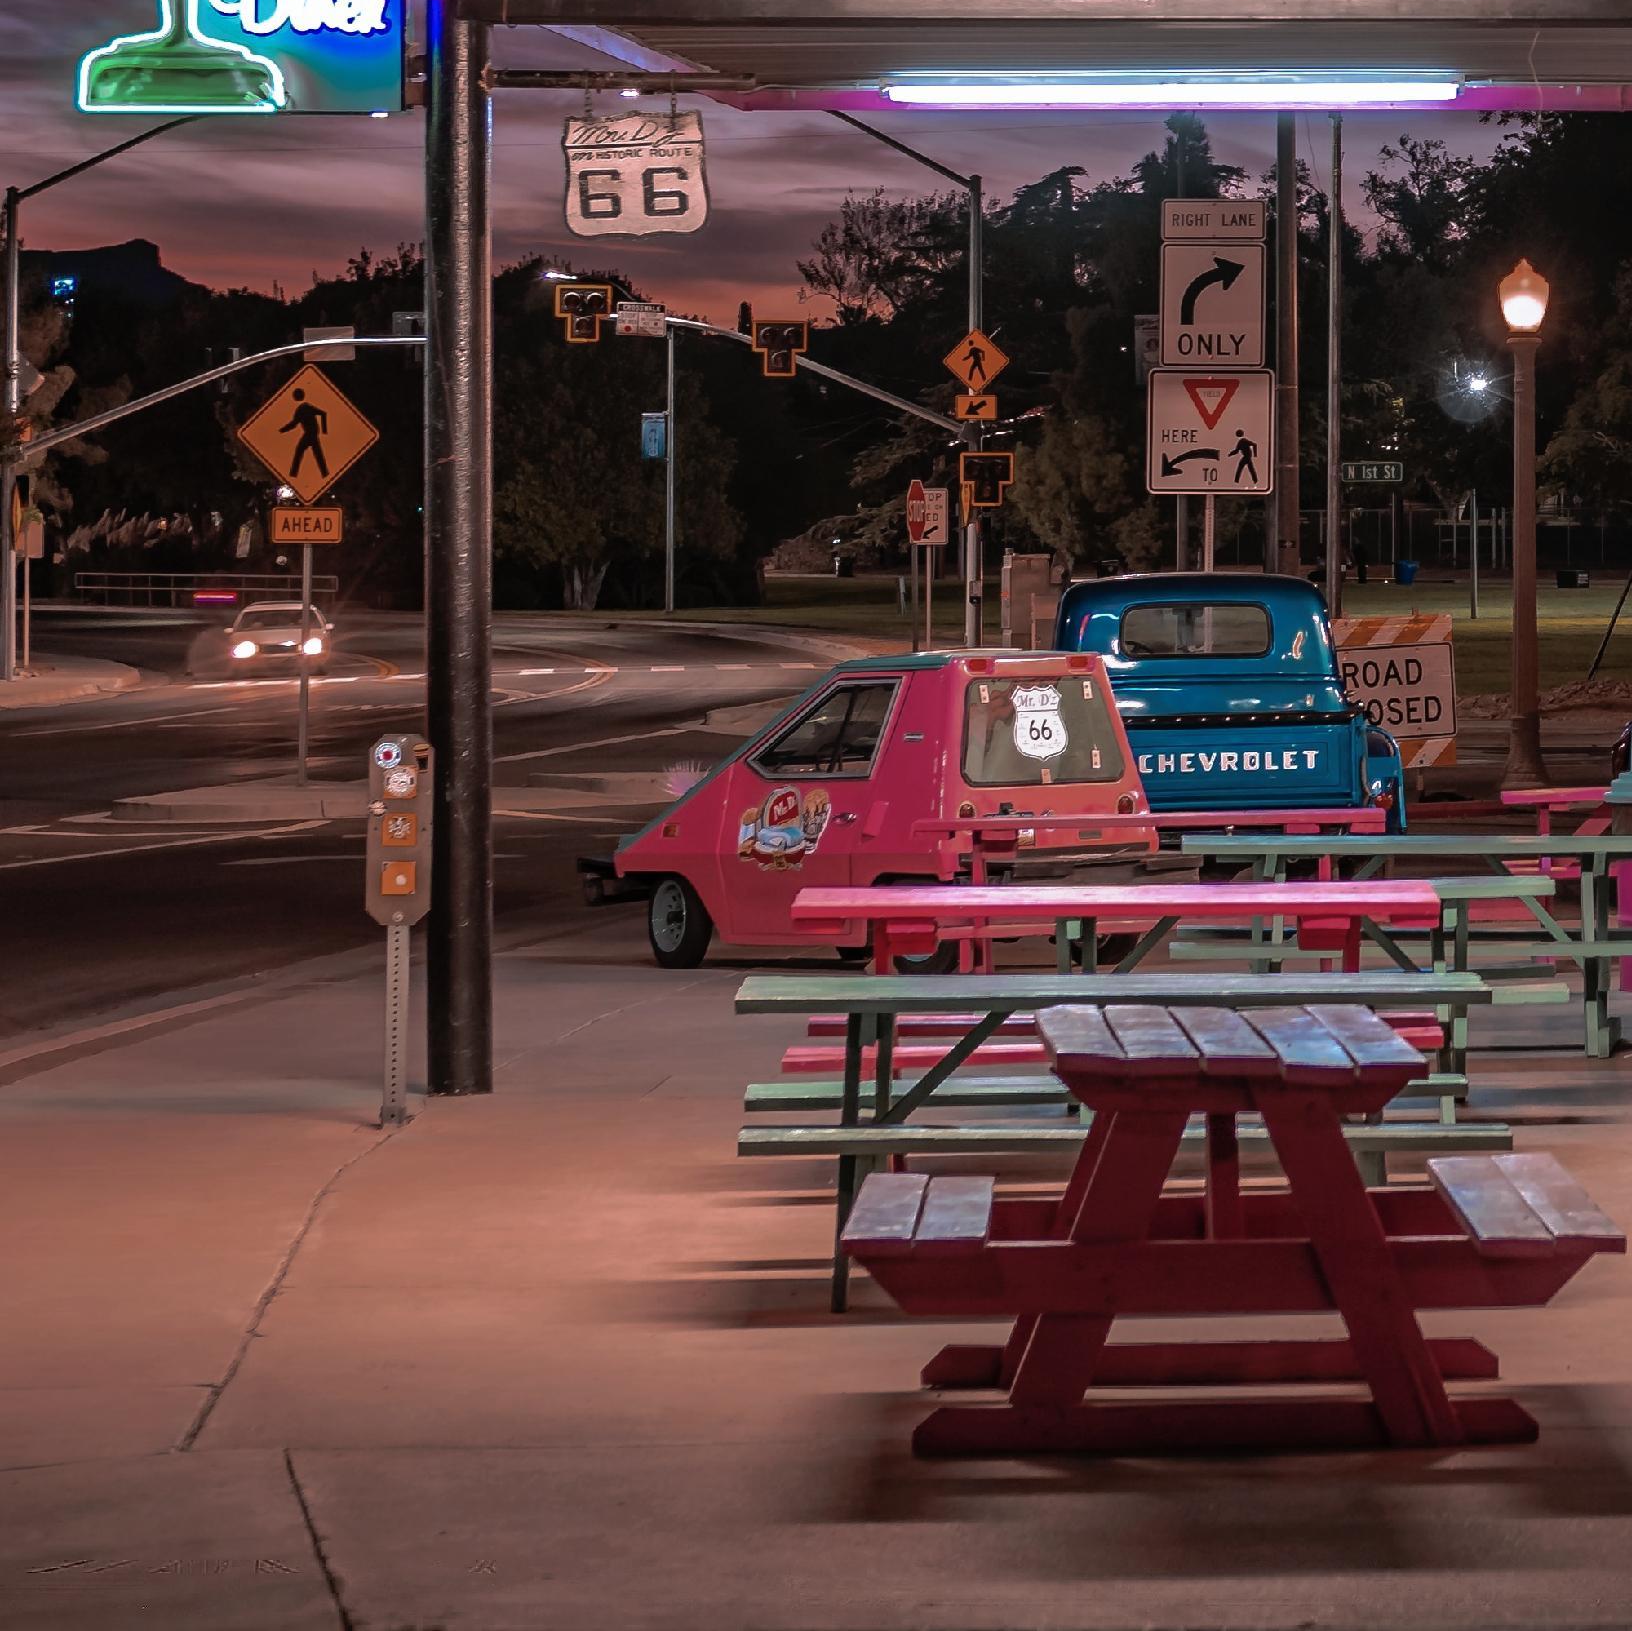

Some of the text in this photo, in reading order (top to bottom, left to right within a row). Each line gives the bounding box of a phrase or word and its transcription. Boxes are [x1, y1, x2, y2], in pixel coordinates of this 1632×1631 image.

[595, 149, 643, 160] HISTORIC
[649, 147, 694, 158] ROUTE
[578, 167, 689, 219] 66
[1171, 213, 1256, 227] RIGHT LANE
[1177, 333, 1246, 356] ONLY
[1162, 430, 1198, 443] HERE
[1202, 468, 1218, 482] TO
[1348, 465, 1355, 479] N
[1384, 465, 1396, 479] St
[909, 500, 925, 522] STOP
[282, 517, 333, 533] AHEAD
[1342, 659, 1422, 688] ROAD
[1017, 695, 1036, 707] Mr.
[1366, 696, 1441, 725] OSED
[1030, 719, 1052, 740] 66
[1138, 751, 1319, 773] CHEVROLET
